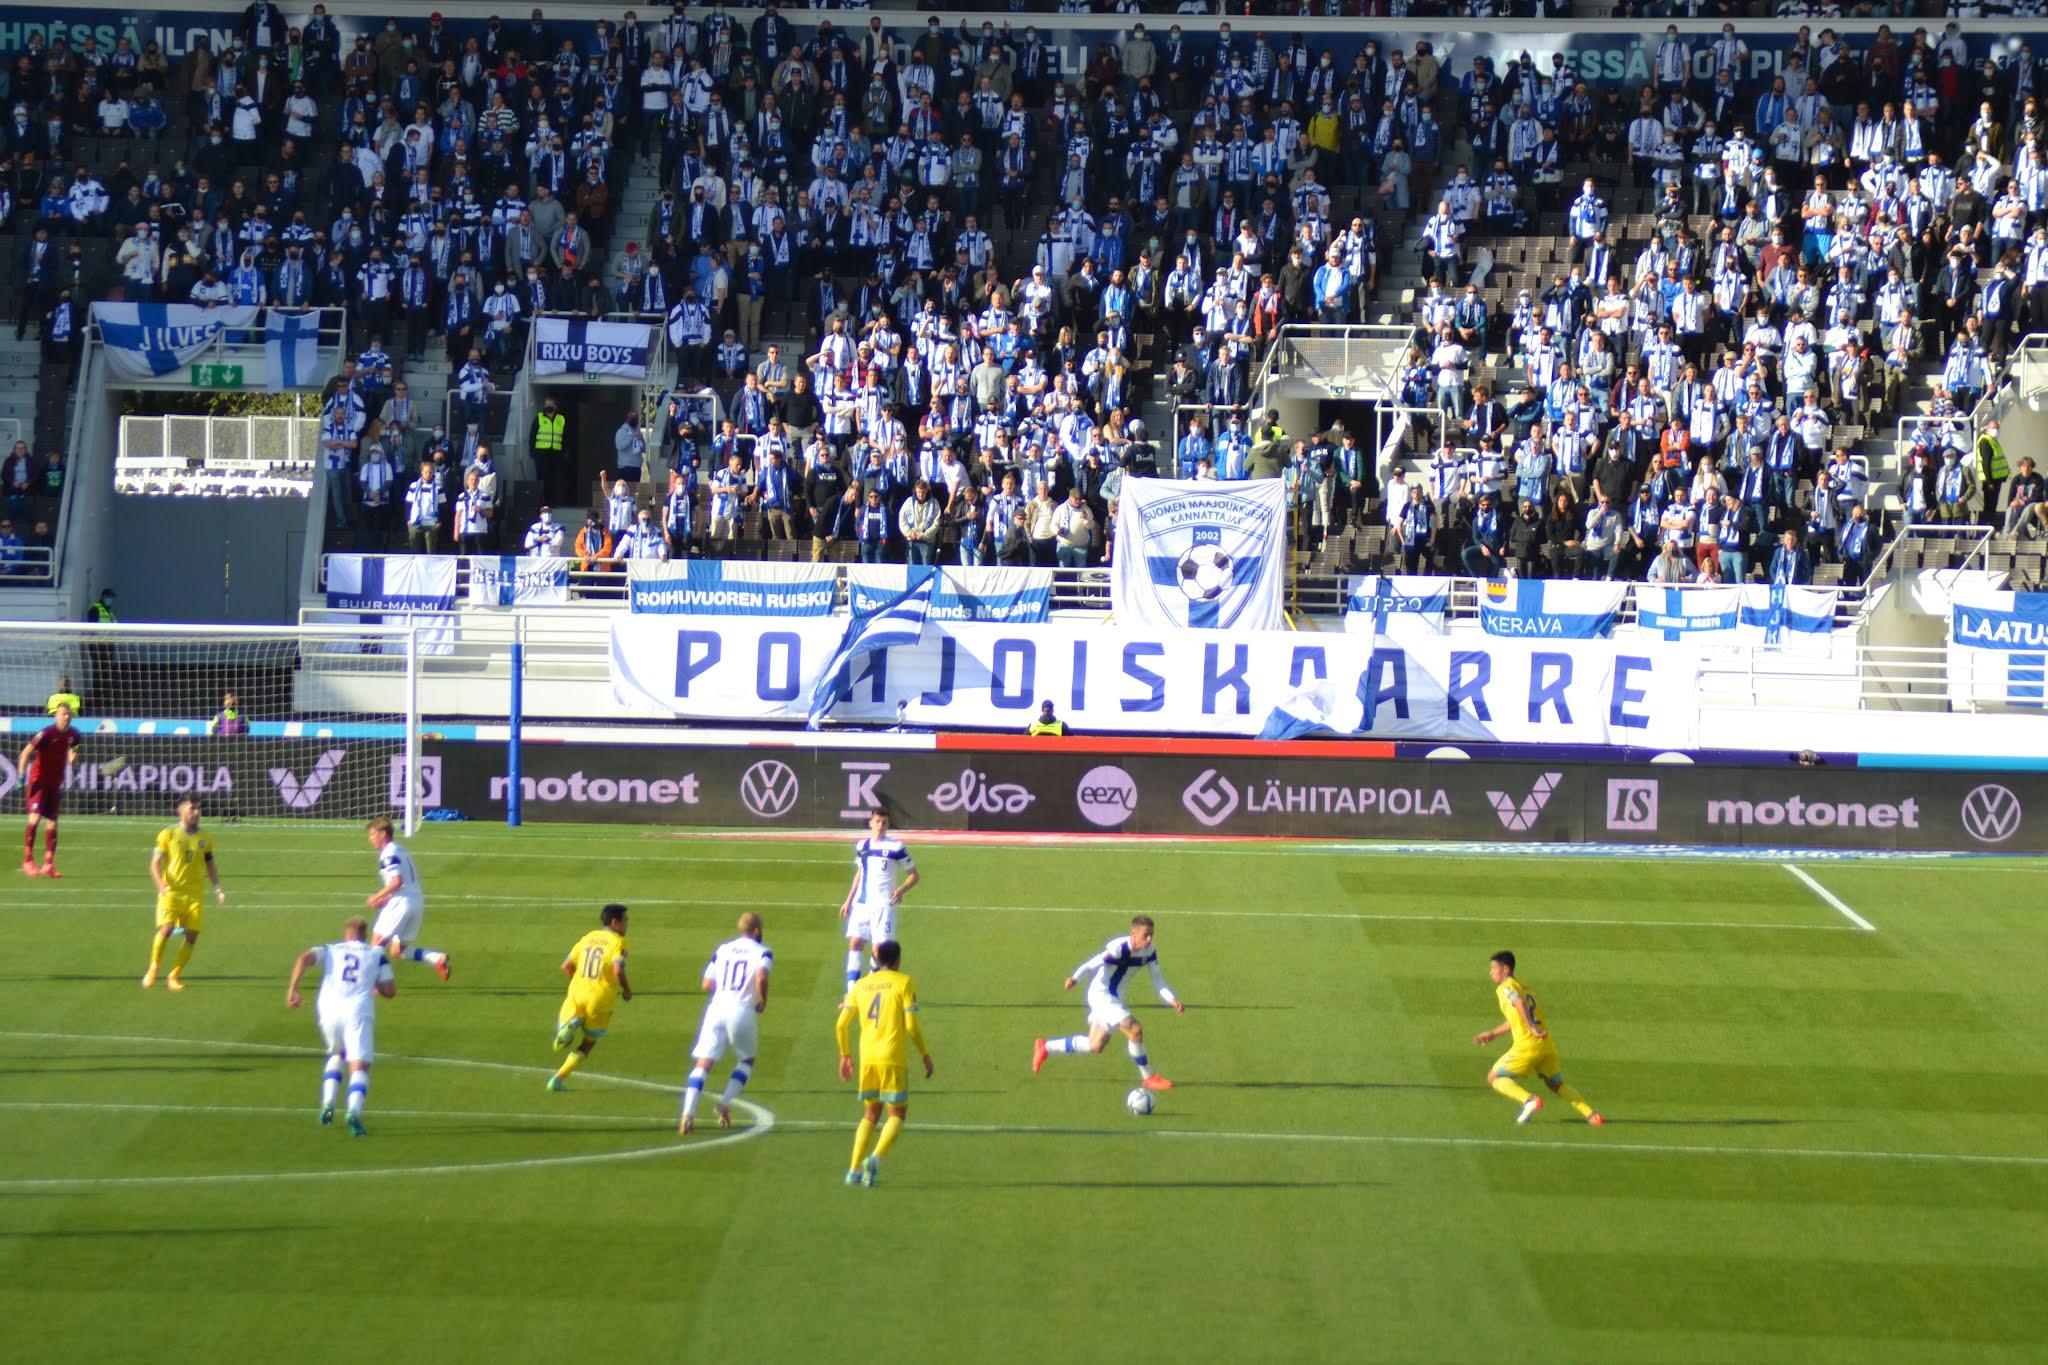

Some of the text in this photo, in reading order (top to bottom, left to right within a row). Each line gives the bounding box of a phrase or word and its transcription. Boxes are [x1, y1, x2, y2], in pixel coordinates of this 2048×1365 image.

[542, 342, 632, 363] RIXU BOYS
[1143, 501, 1187, 522] SUOMEN
[1195, 531, 1219, 541] 2002
[338, 598, 439, 611] SUUR-MALMI
[635, 589, 833, 609] ROIHUVUOREN RUISKU
[1487, 613, 1563, 635] KERAVA
[1961, 614, 2048, 645] LAATU
[490, 770, 699, 804] motonet
[927, 768, 1037, 813] elisa
[1081, 786, 1136, 811] eezy
[1246, 779, 1452, 816] LÄHITAPIOLA
[1612, 788, 1652, 823] IS
[1707, 794, 1920, 829] motonet
[342, 954, 360, 983] 2
[582, 947, 604, 980] 16
[721, 959, 748, 991] 10
[867, 992, 882, 1029] 4
